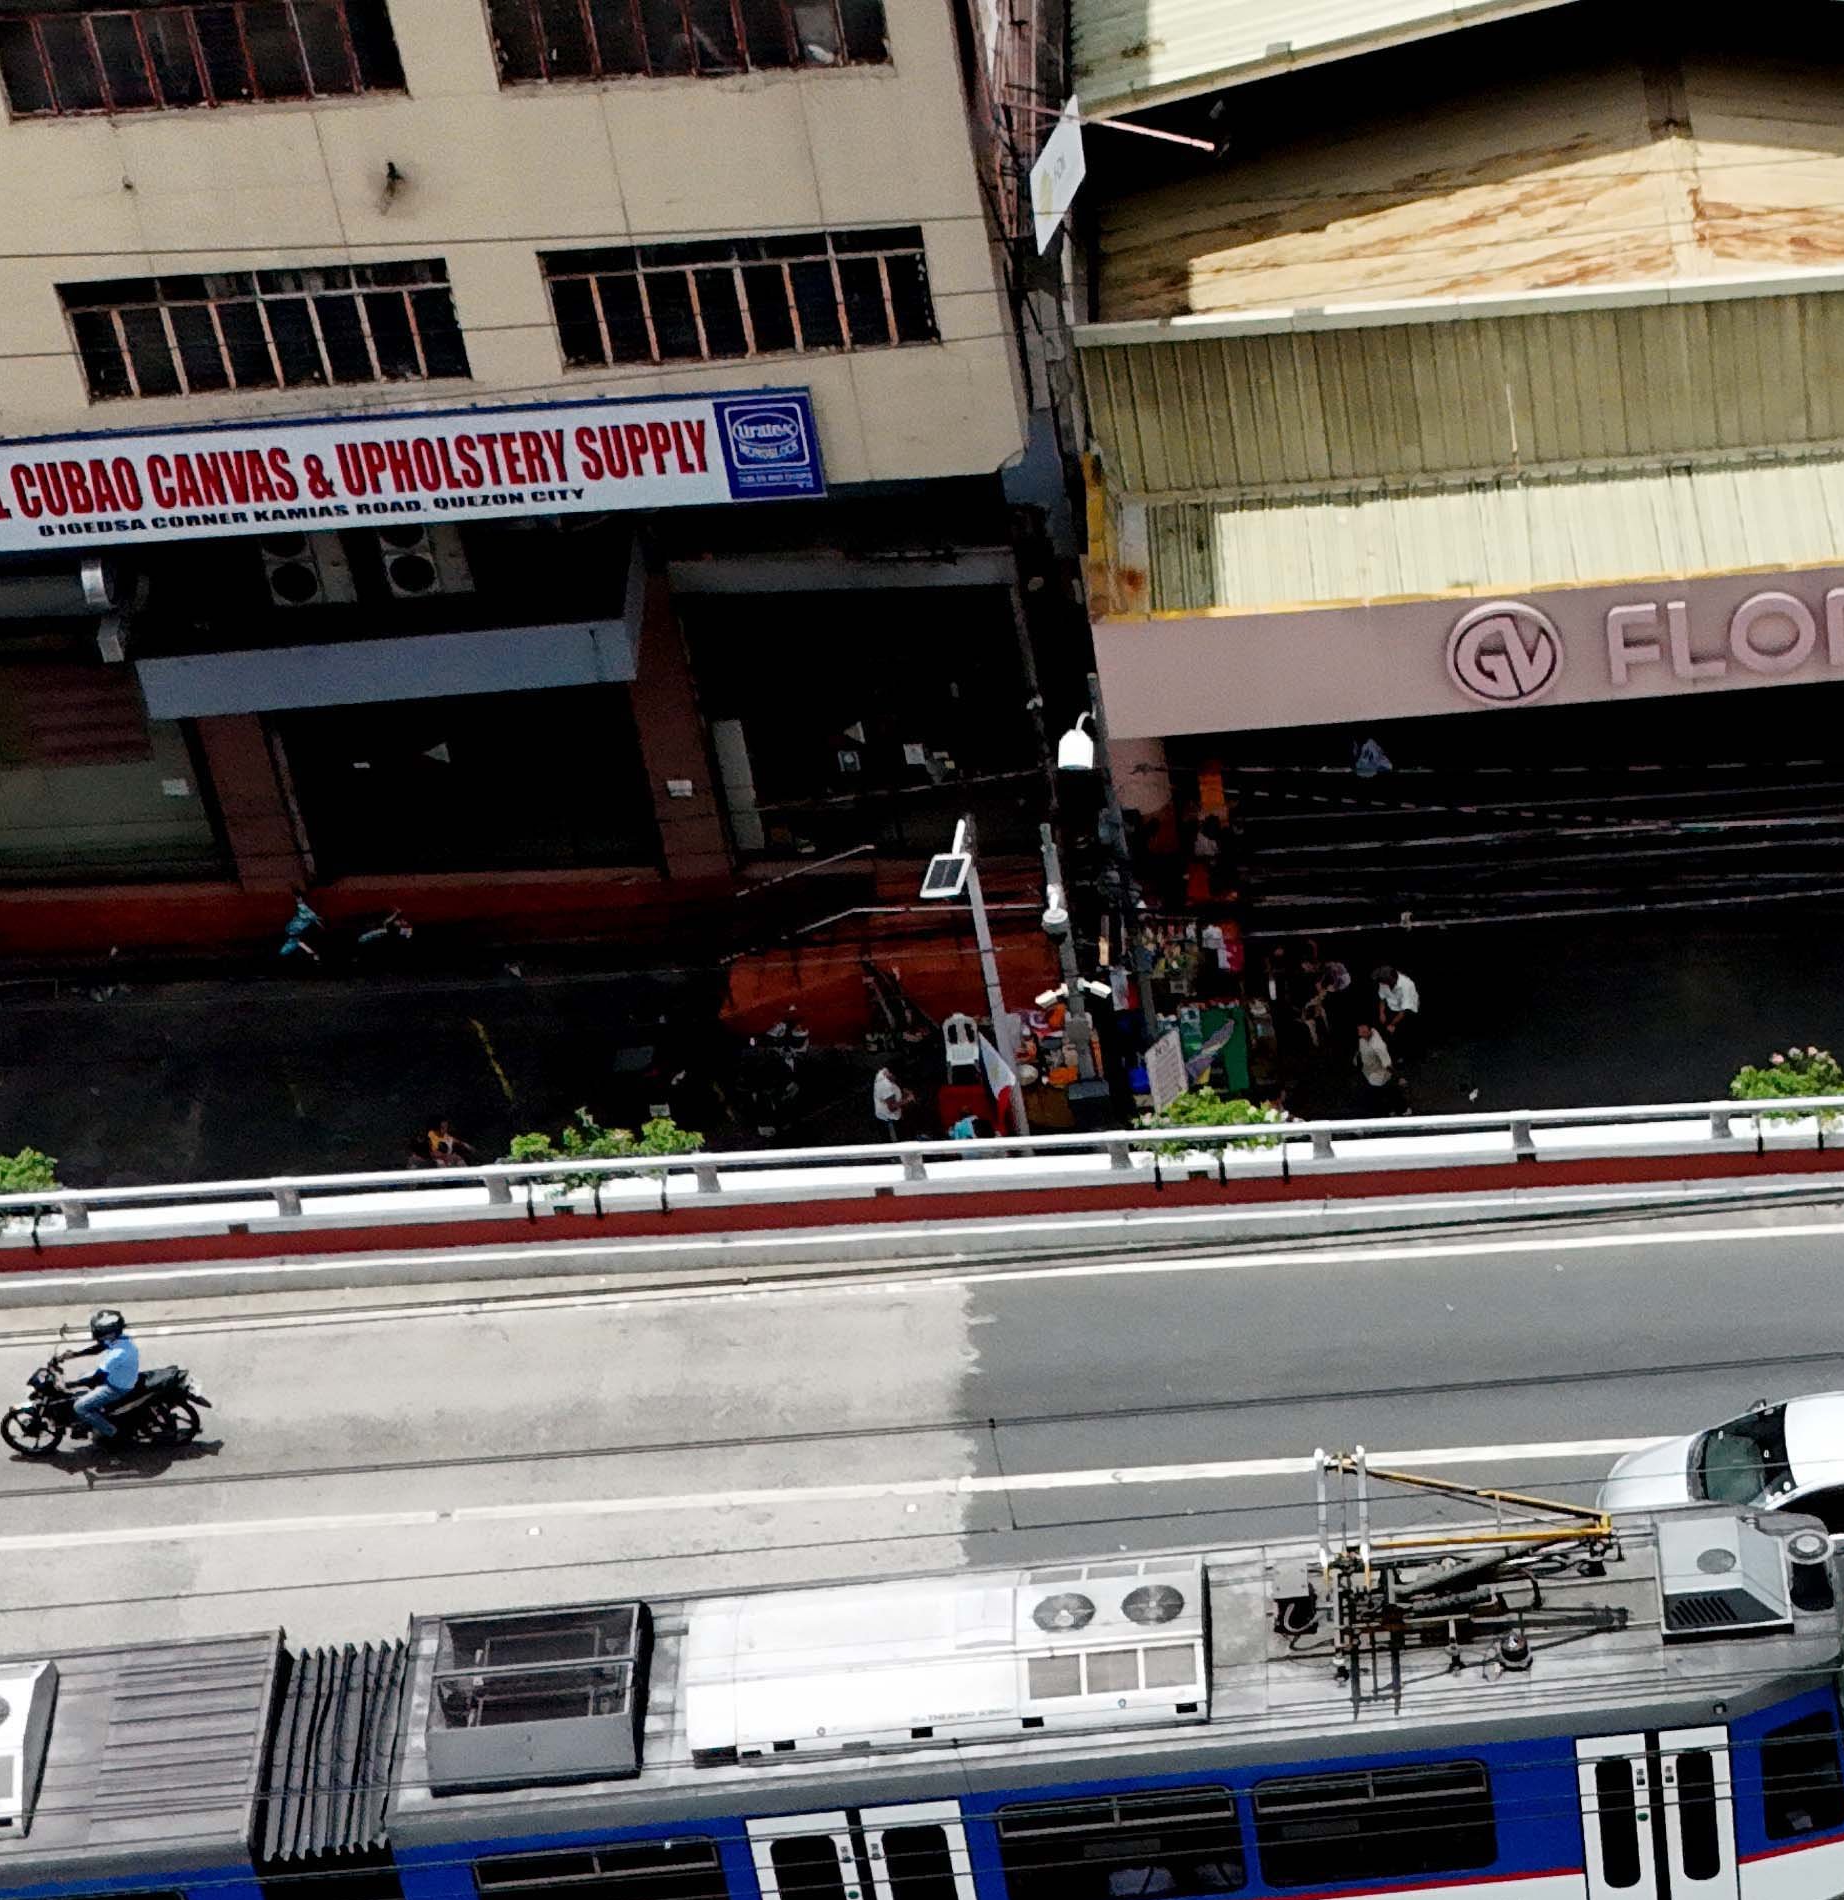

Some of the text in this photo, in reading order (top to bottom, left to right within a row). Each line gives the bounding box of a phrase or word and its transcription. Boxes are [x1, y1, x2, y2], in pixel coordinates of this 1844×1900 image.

[10, 457, 145, 519] CUBAO
[147, 446, 299, 511] CANVAS
[305, 453, 335, 500] &
[335, 428, 570, 497] UPHOLSTERY
[575, 419, 709, 481] SUPPLY
[152, 511, 248, 529] CORNER
[254, 504, 349, 523] KAMIAS
[434, 493, 525, 511] QUEZON
[531, 488, 586, 502] CITY
